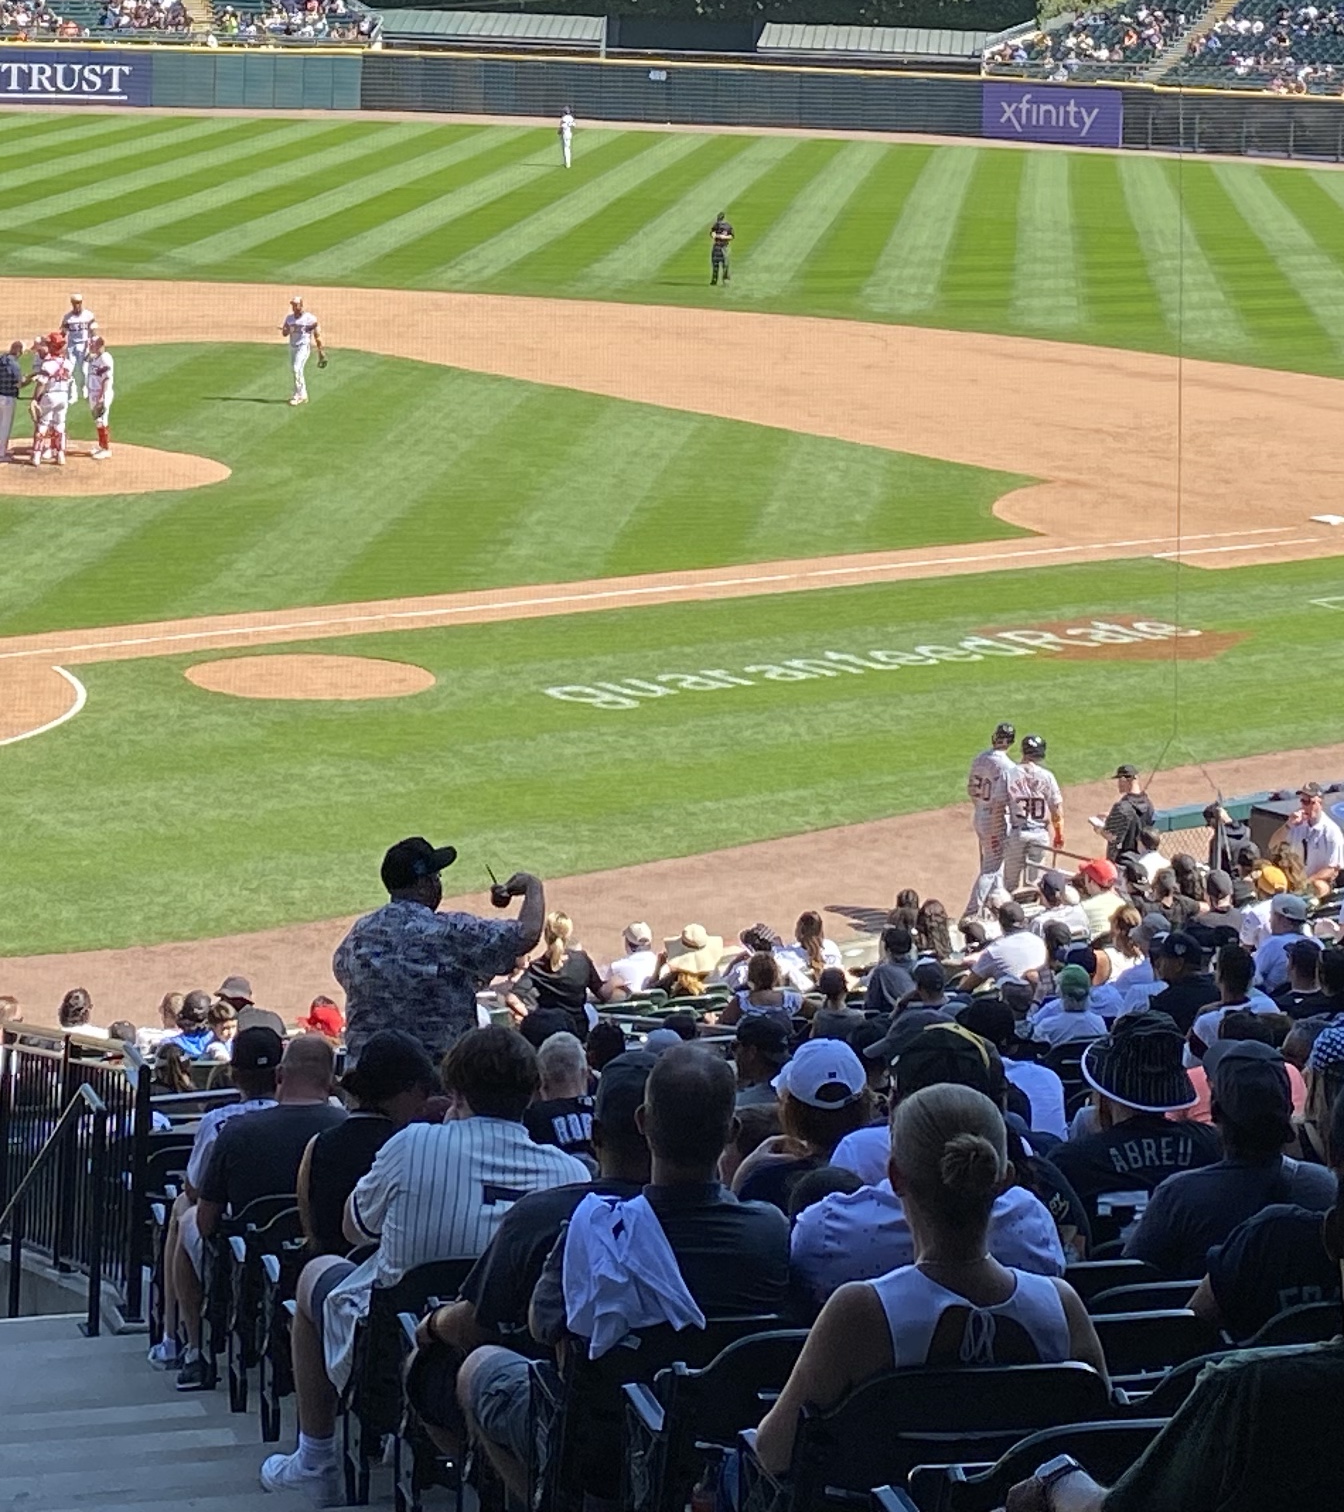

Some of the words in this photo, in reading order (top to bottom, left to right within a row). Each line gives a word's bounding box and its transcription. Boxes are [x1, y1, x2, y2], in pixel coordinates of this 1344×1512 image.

[1001, 93, 1099, 135] xfinity
[546, 636, 1038, 710] guaranteed
[996, 617, 1202, 652] Rate
[1016, 798, 1045, 819] 30
[1109, 1137, 1192, 1173] ABREU
